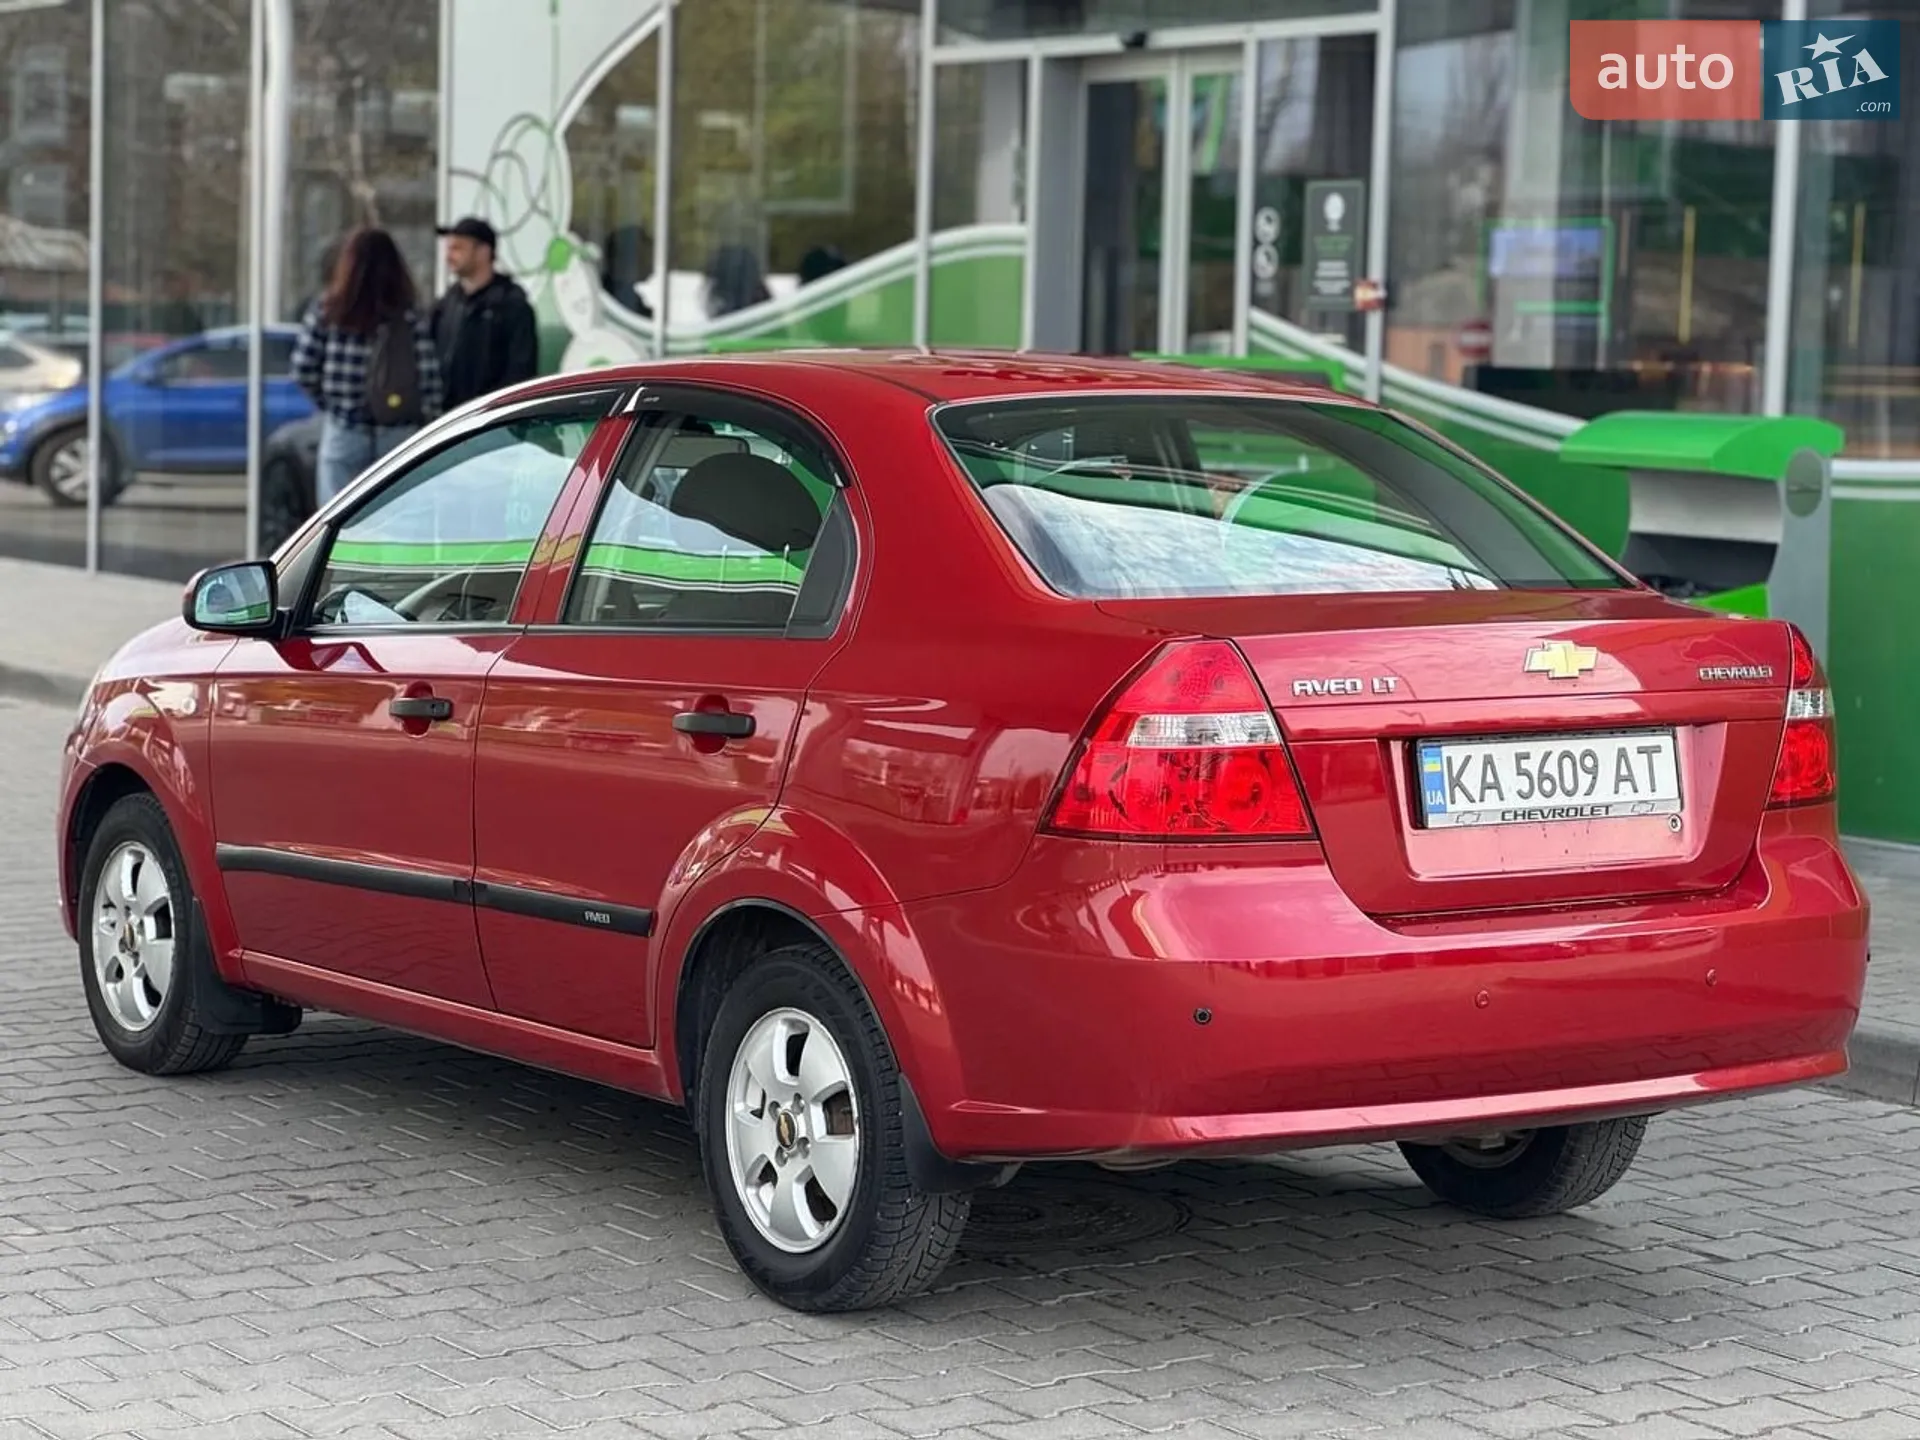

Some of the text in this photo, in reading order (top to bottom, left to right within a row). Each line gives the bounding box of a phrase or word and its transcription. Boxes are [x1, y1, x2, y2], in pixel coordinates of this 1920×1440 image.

[1699, 665, 1773, 680] CHEVROLET
[1292, 676, 1399, 697] AVEO LT
[1446, 744, 1662, 805] KA 5609 AT
[1427, 790, 1445, 806] UA
[1501, 804, 1613, 822] CHEVROLET
